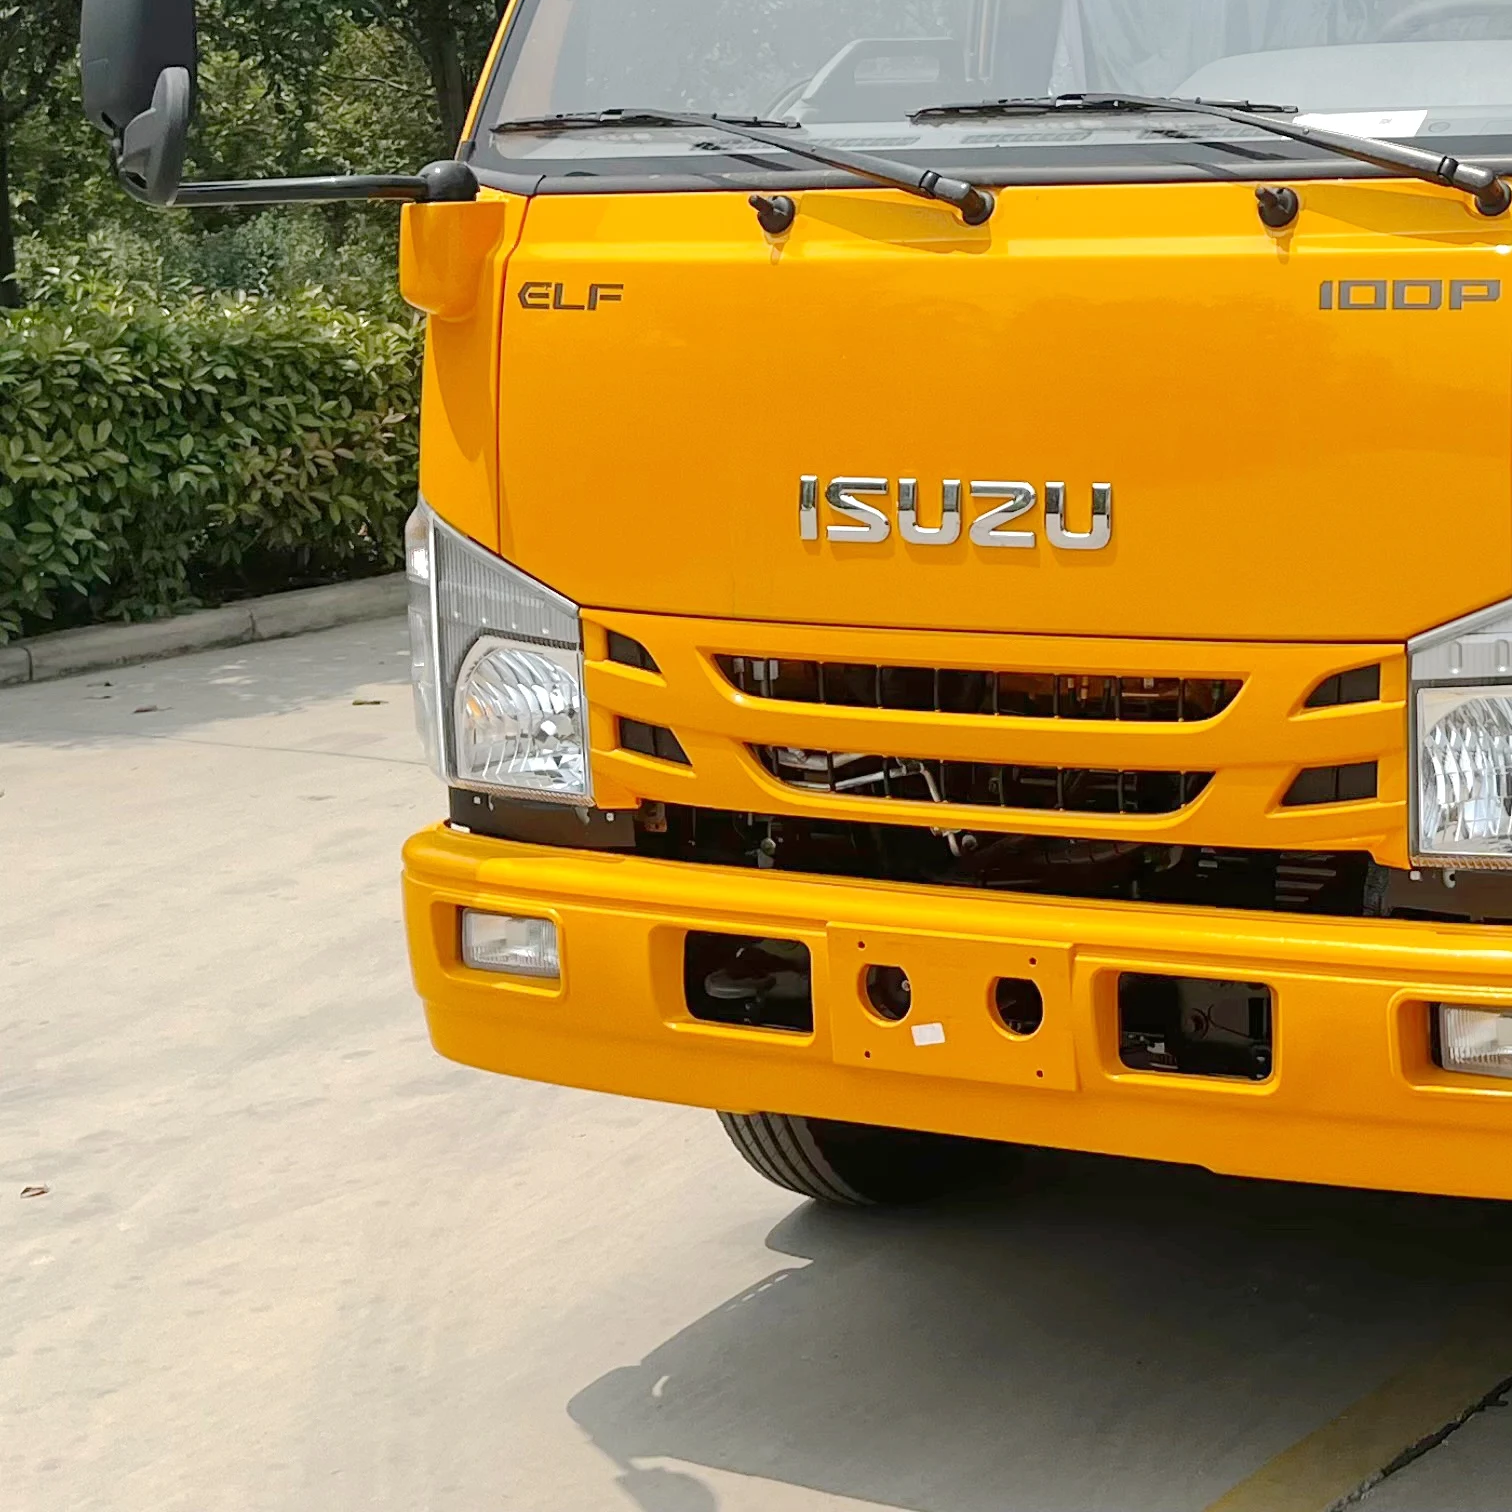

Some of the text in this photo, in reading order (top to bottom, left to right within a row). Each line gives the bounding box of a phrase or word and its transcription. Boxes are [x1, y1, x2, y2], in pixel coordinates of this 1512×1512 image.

[517, 281, 624, 311] ELF
[1319, 279, 1501, 310] 100P
[799, 474, 1113, 551] ISUZU
